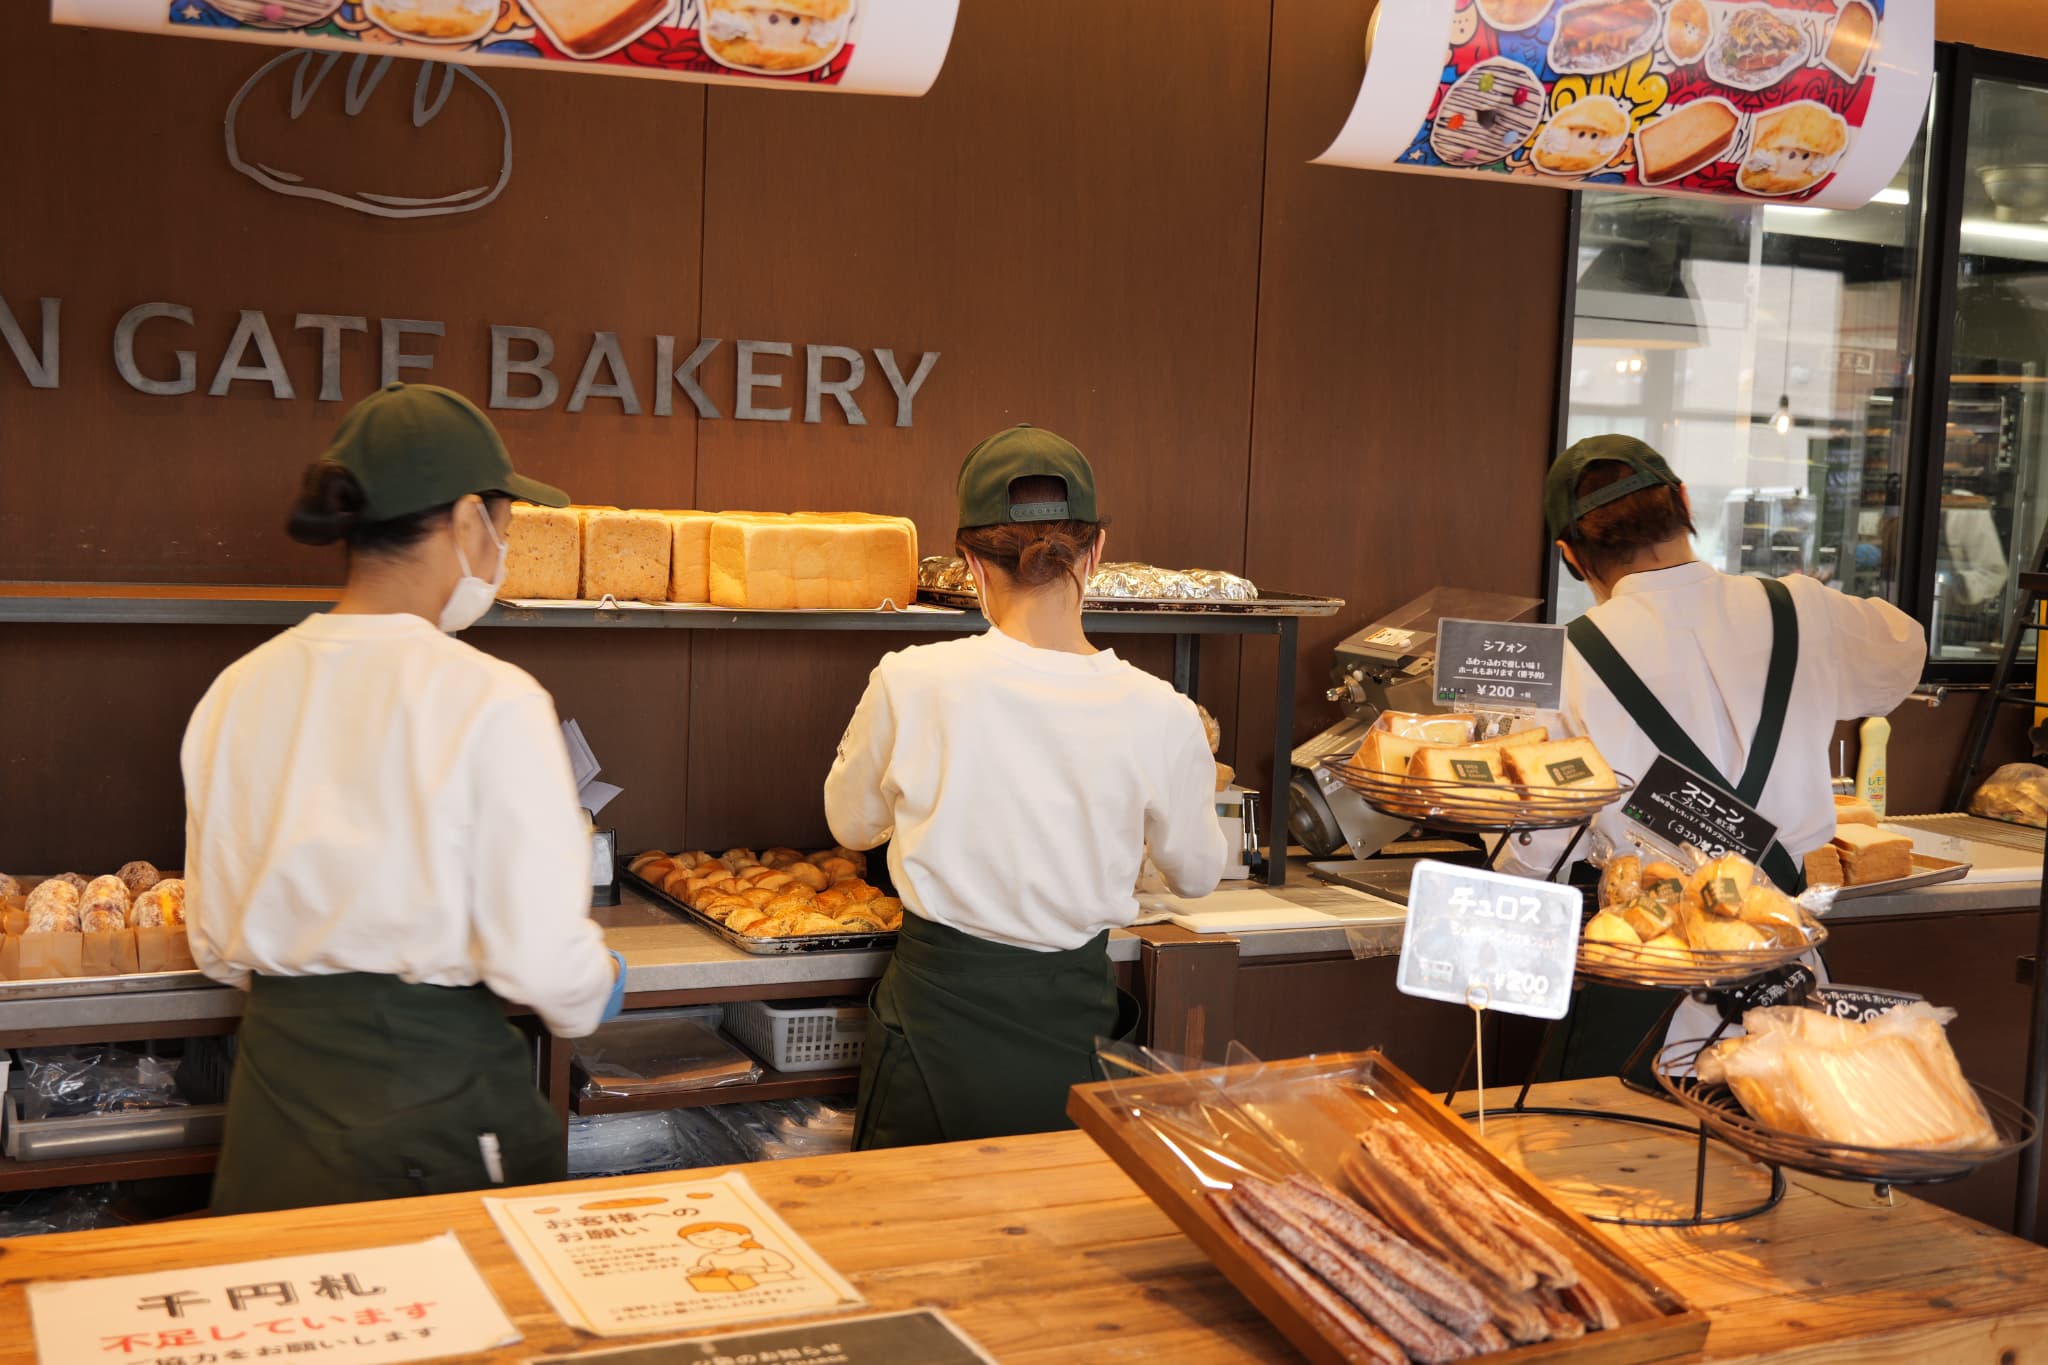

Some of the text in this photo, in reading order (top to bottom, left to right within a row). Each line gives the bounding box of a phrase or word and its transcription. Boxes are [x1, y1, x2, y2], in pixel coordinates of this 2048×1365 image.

[488, 324, 942, 428] BAKERY
[1483, 640, 1527, 653] シフォン
[1477, 684, 1515, 698] ¥200
[1681, 781, 1744, 823] スコーン
[1448, 887, 1542, 924] チュロス
[544, 1206, 700, 1230] お客様への
[554, 1224, 650, 1245] お願い
[137, 1272, 387, 1318] 千円札
[101, 1301, 441, 1354] 不足しています
